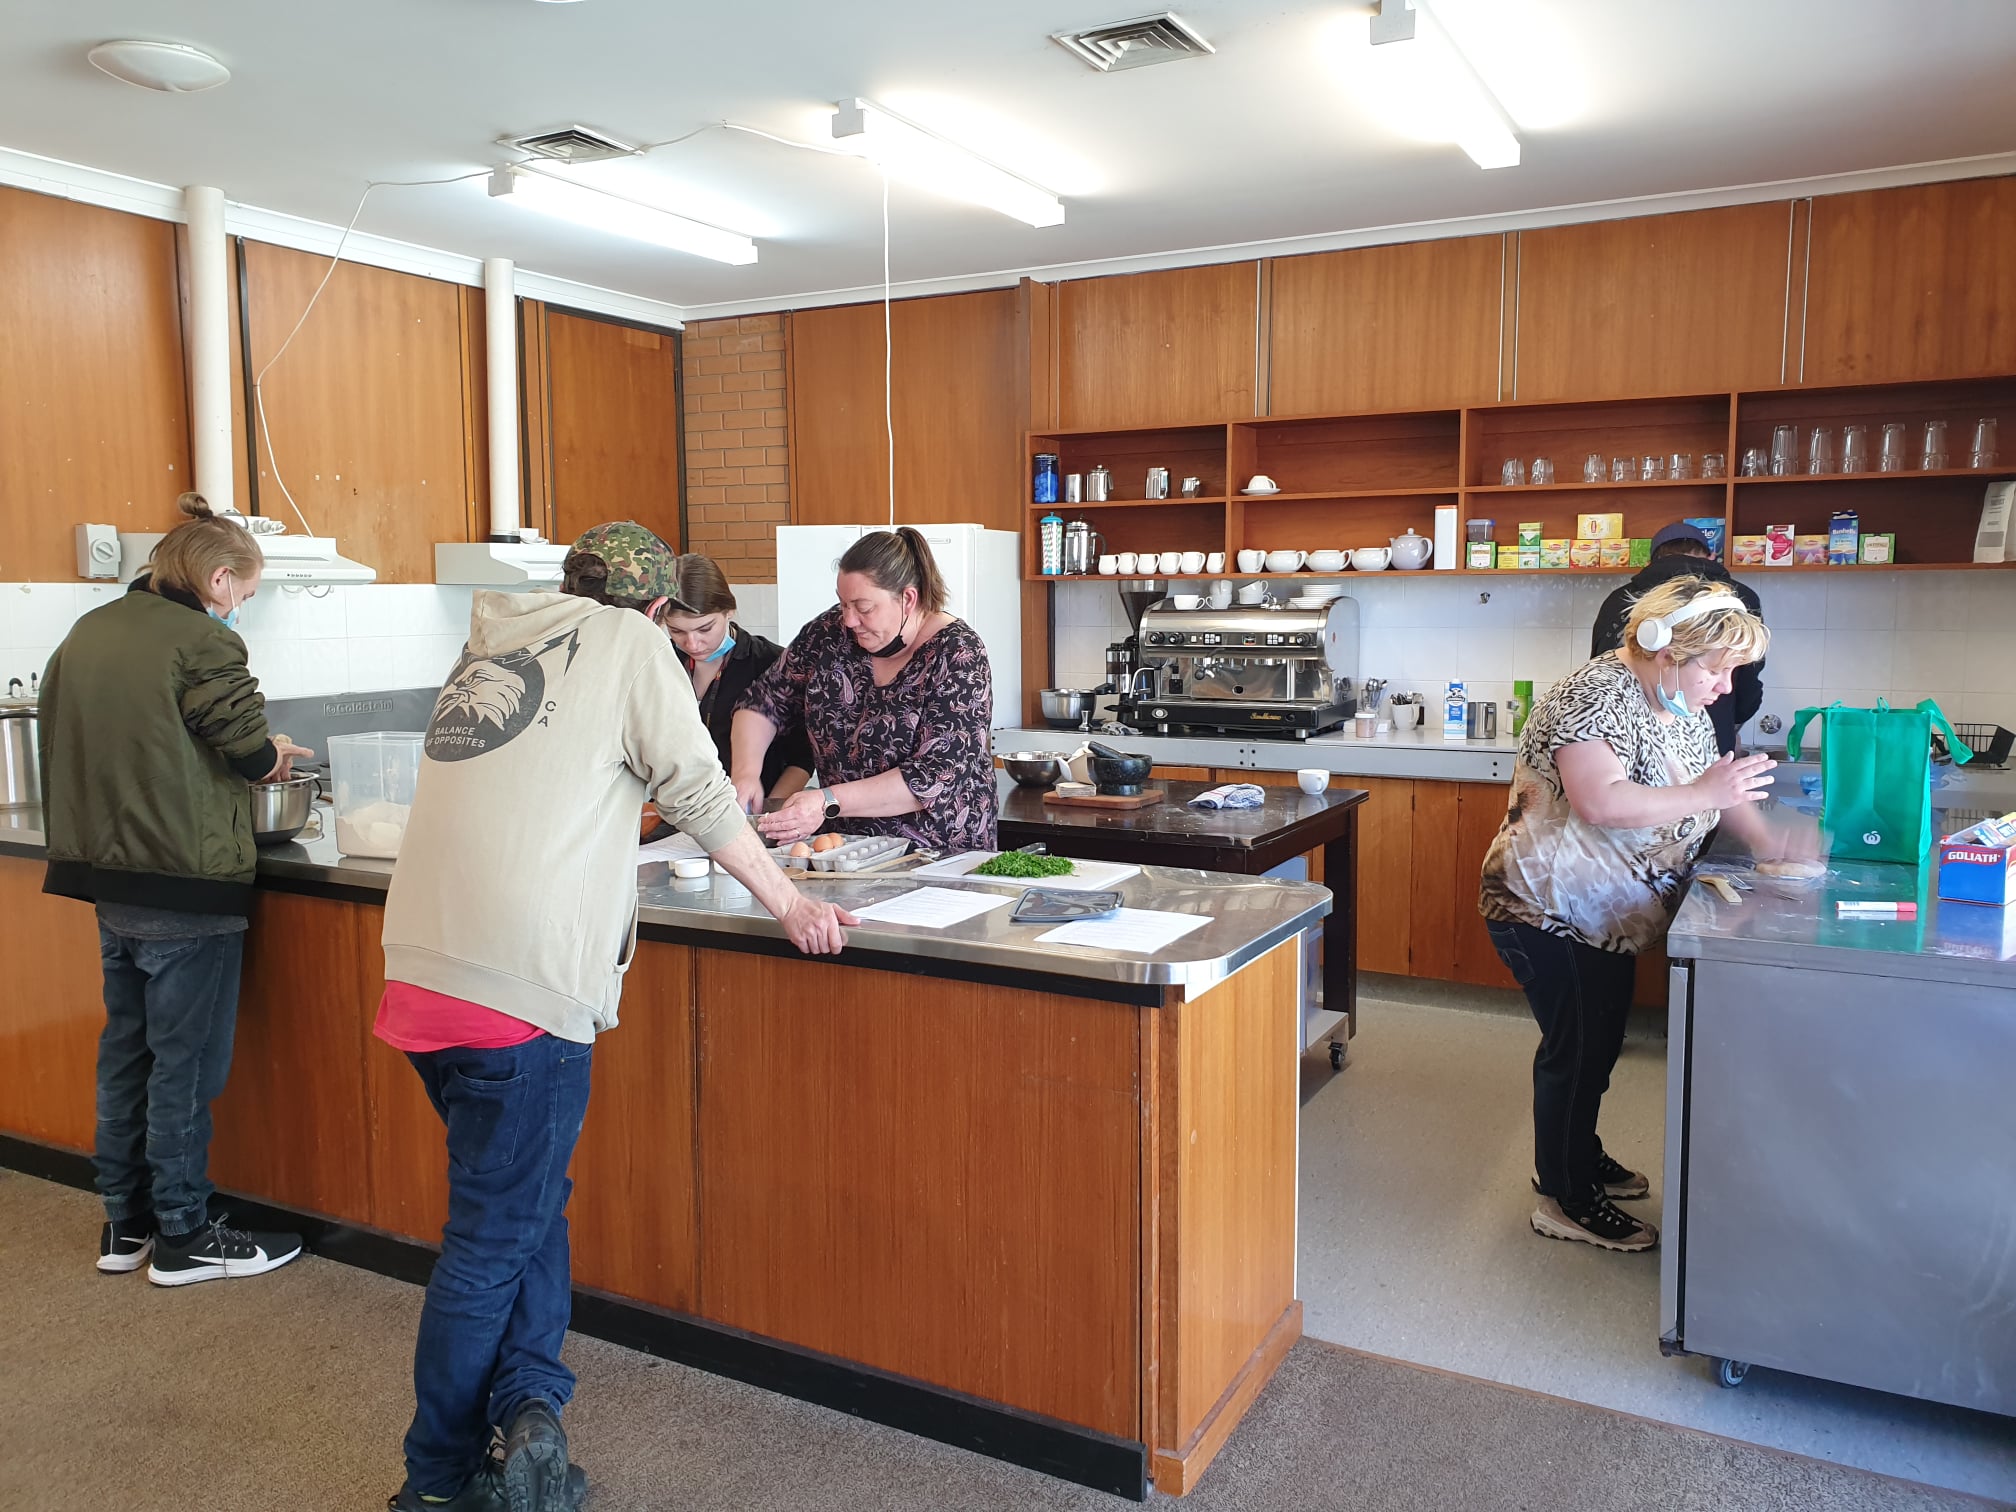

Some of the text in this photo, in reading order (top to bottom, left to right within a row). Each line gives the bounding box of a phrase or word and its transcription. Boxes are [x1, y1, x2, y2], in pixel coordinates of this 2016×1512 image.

[337, 699, 391, 714] Goldstein
[545, 700, 557, 712] C
[537, 715, 548, 727] A
[435, 726, 476, 736] BALANCE
[434, 736, 486, 748] OPPOSITES
[1947, 850, 1999, 863] GOLIATH
